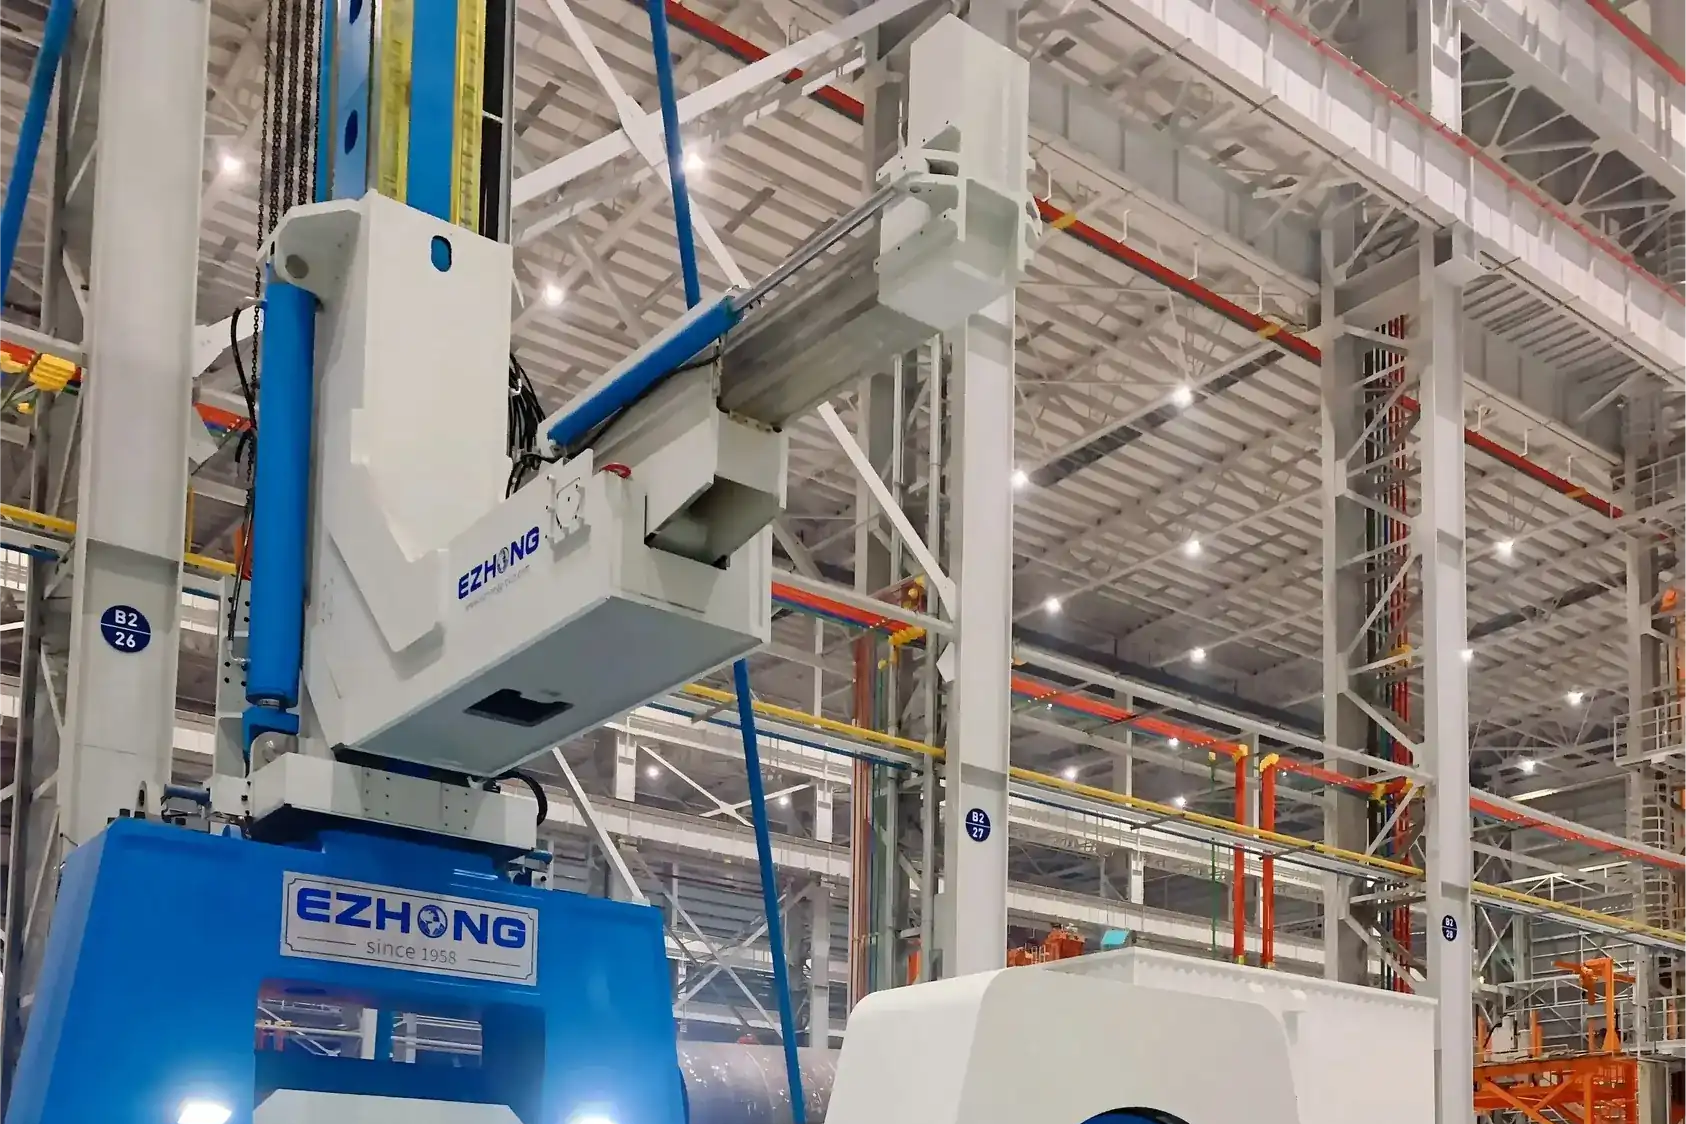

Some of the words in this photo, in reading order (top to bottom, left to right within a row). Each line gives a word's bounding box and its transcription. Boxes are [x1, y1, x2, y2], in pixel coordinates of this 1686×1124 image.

[458, 526, 540, 600] EZHONG
[115, 609, 138, 627] B2
[115, 631, 136, 648] 26
[972, 811, 985, 824] B2
[972, 827, 984, 839] 27
[296, 887, 526, 949] EZHONG
[366, 938, 416, 960] since
[421, 947, 457, 965] 1958
